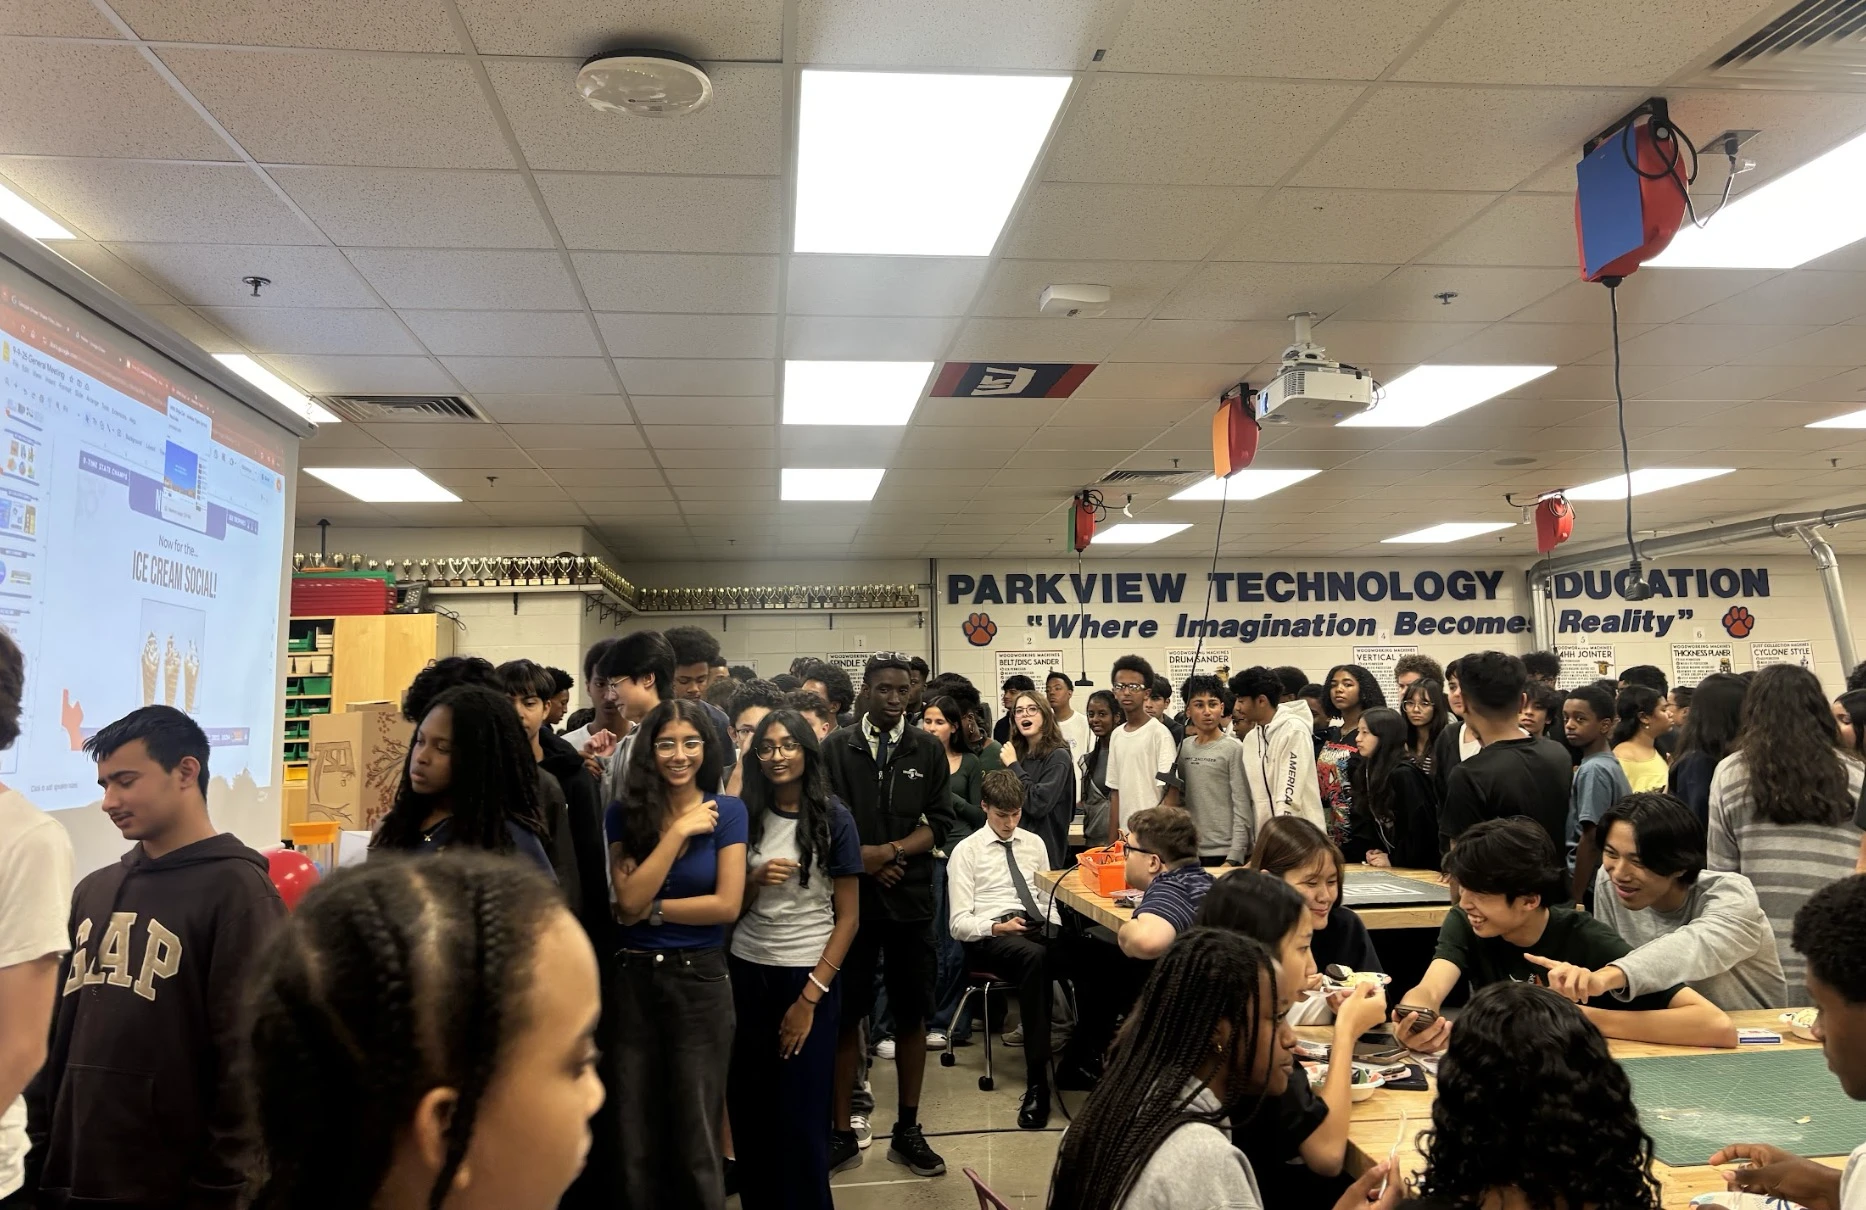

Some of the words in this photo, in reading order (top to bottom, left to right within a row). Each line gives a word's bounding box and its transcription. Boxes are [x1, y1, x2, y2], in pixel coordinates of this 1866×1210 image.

[158, 534, 174, 550] Now
[174, 538, 184, 553] for
[132, 549, 149, 583] ICE
[150, 554, 183, 591] CREAM
[184, 564, 218, 599] SOCIAL!
[947, 572, 1187, 605] PARKVIEW
[1207, 570, 1505, 602] TECHNOLOGY
[1526, 568, 1771, 600] DUATION
[1175, 611, 1377, 644] Imagination
[1577, 650, 1613, 659] JOINTER
[1673, 649, 1708, 657] THICKNESS
[1708, 649, 1731, 657] PLANER
[1753, 648, 1789, 656] CYCLONE
[1790, 647, 1811, 655] STYLE
[1169, 655, 1194, 664] DRUM
[1195, 655, 1229, 663] SANDER
[1356, 653, 1397, 662] VERTICAL
[830, 659, 861, 668] SPNDLE
[999, 659, 1033, 667] BELT/DISC
